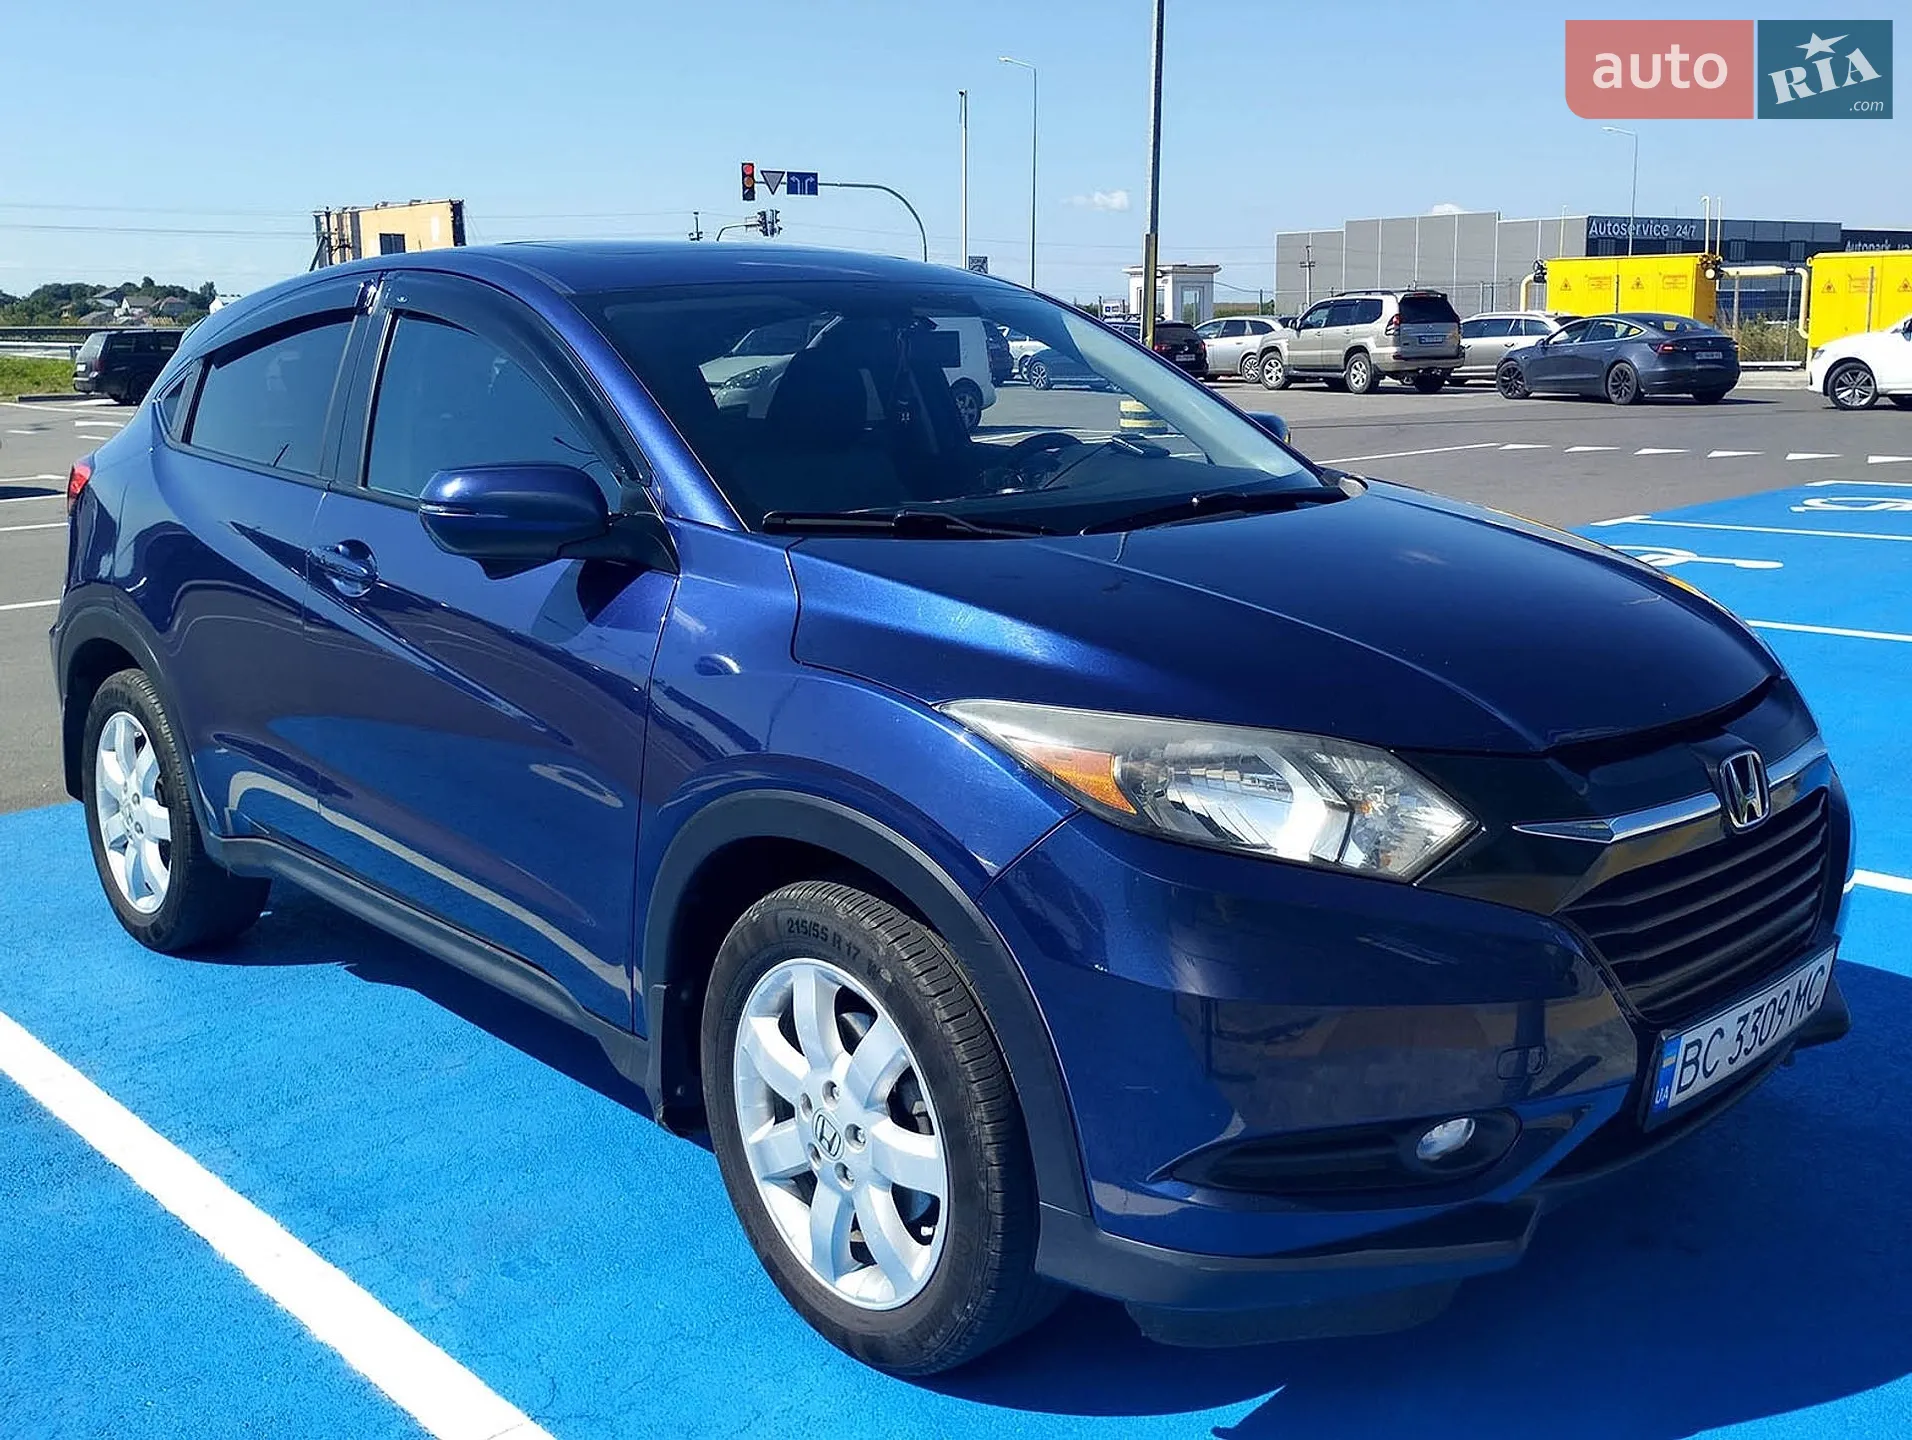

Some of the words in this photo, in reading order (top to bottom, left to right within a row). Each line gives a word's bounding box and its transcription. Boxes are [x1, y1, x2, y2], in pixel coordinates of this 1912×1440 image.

[1588, 219, 1670, 237] Autoservice
[1675, 223, 1697, 237] 24/7
[786, 917, 829, 943] 215/55
[832, 931, 843, 951] R
[845, 941, 861, 961] 17
[1675, 1027, 1725, 1096] BC
[1727, 988, 1791, 1066] 3309
[1788, 964, 1826, 1027] MC
[1654, 1085, 1670, 1105] UA
